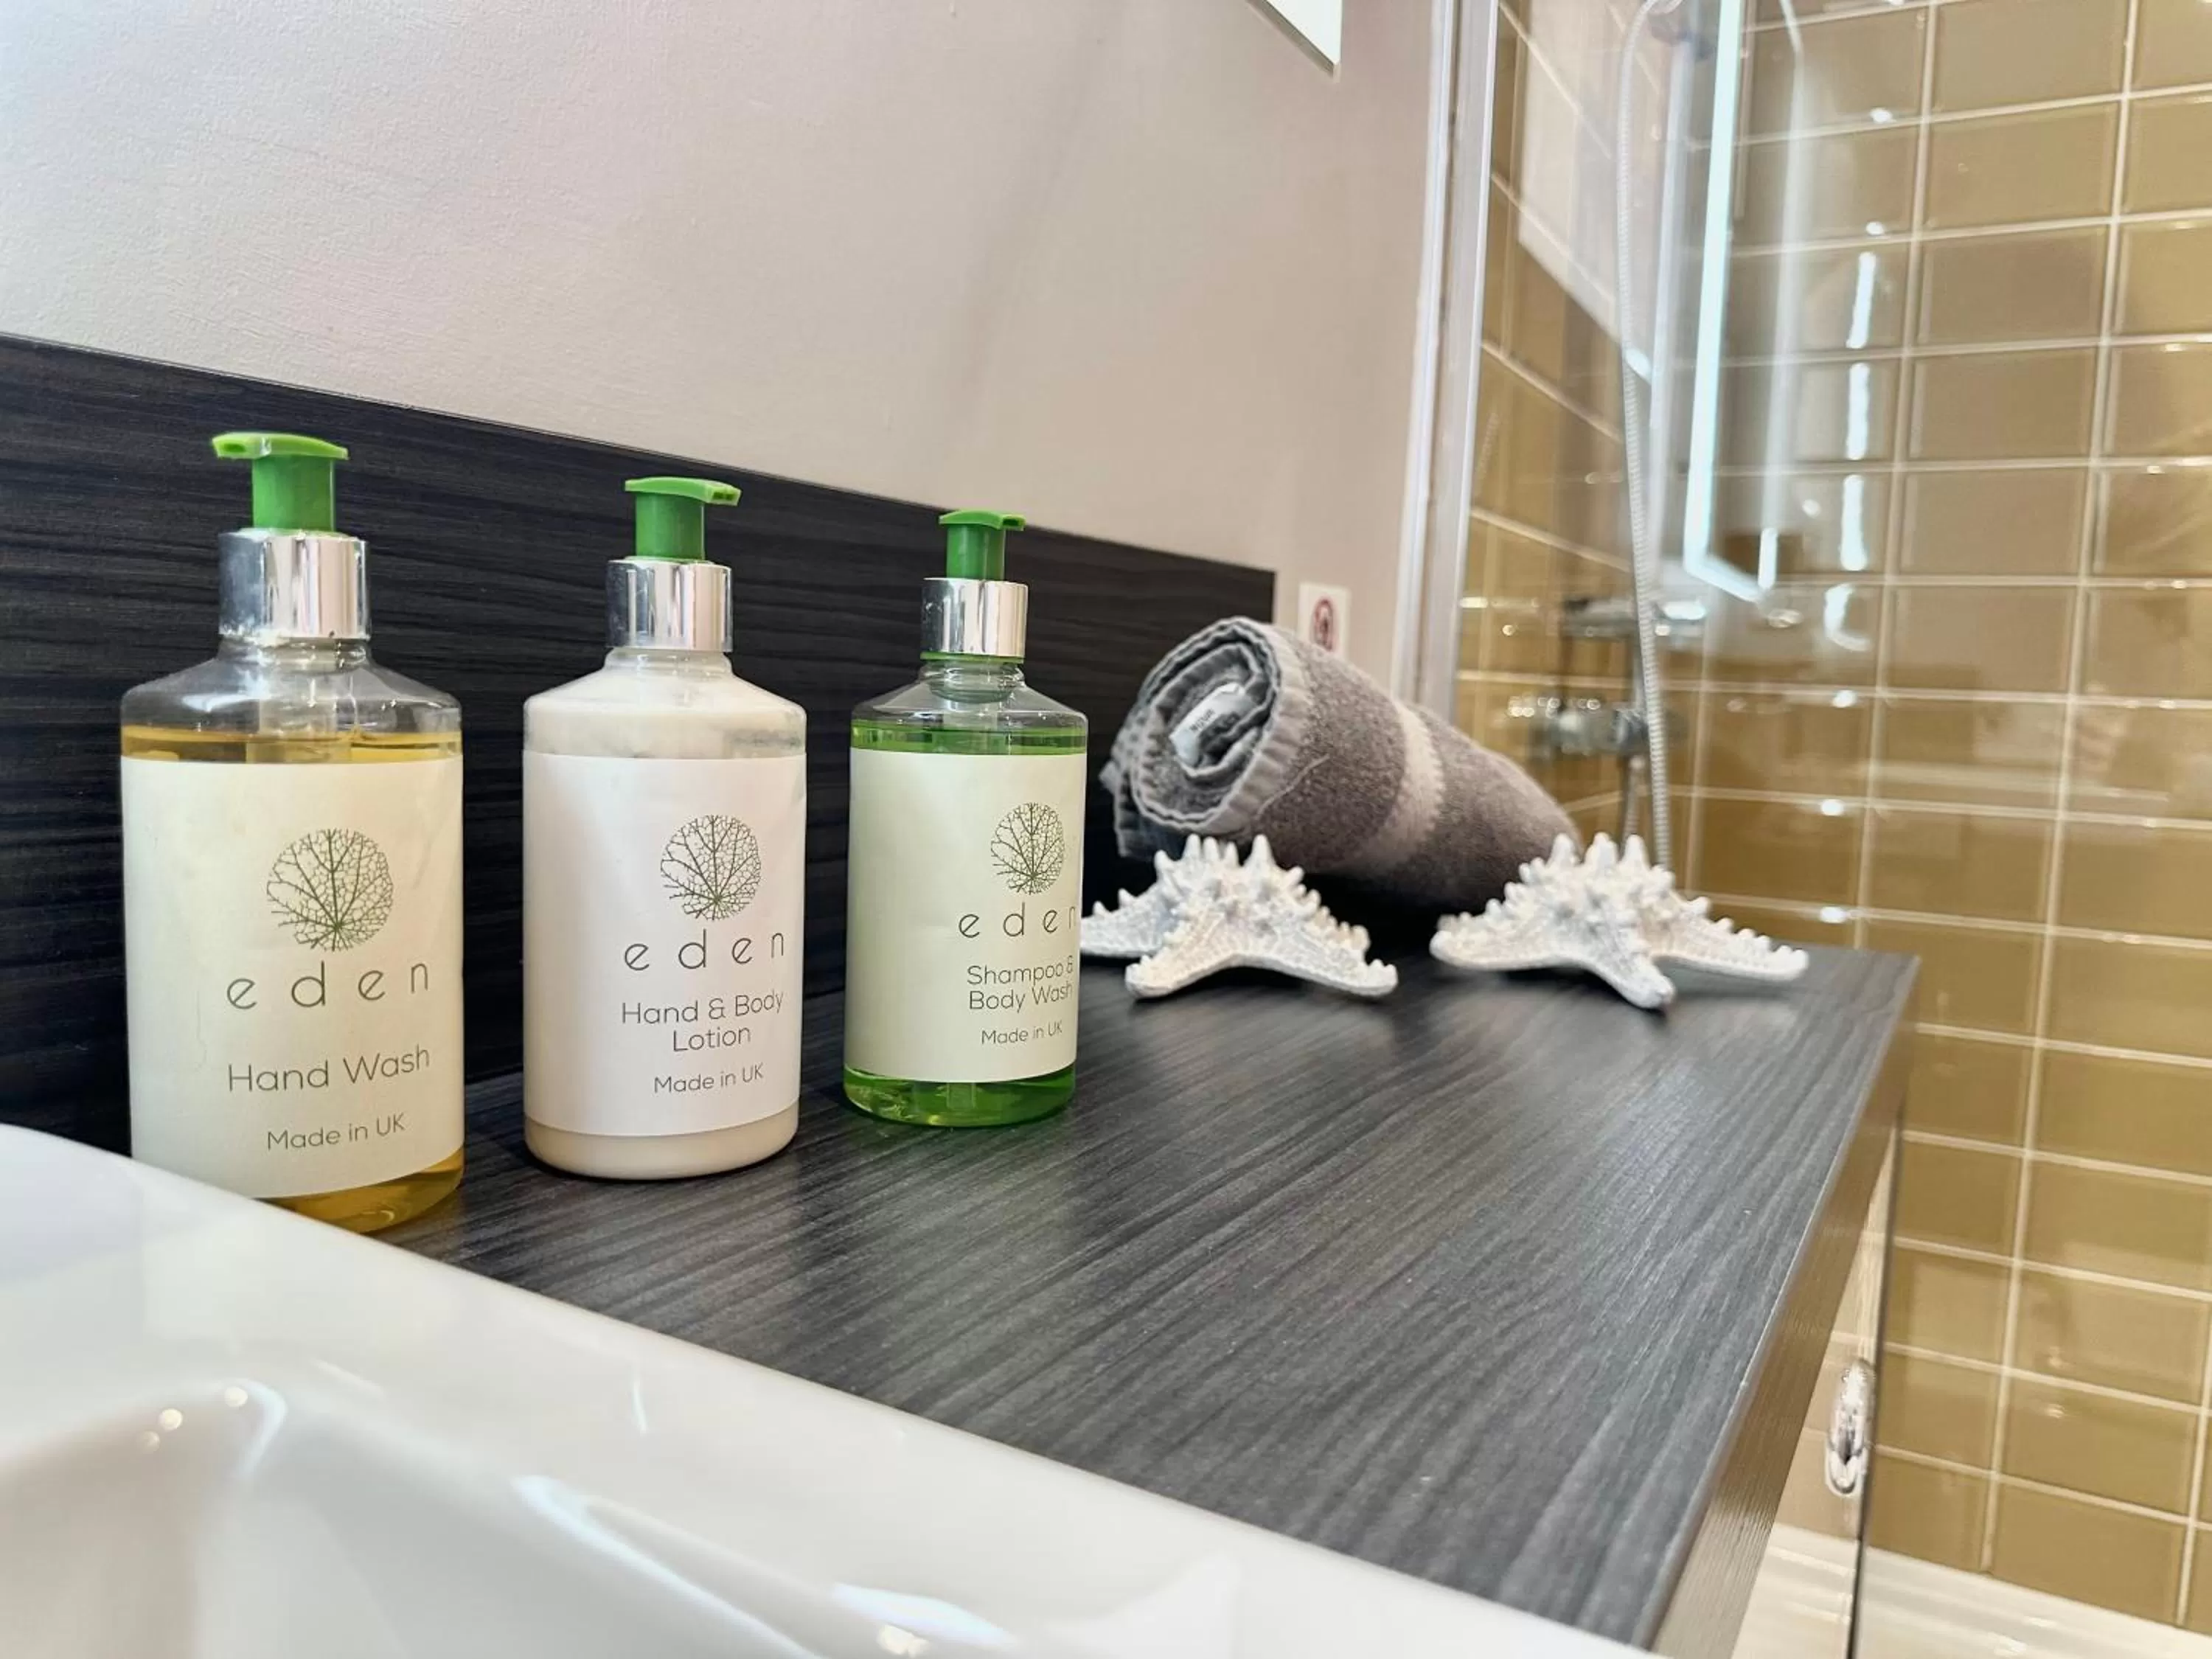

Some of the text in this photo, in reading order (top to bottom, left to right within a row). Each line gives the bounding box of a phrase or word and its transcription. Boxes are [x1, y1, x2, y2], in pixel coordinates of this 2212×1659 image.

[959, 902, 1077, 938] eden
[624, 928, 785, 971] eden
[226, 960, 429, 1009] eden
[967, 964, 1064, 986] Shampoo
[622, 990, 784, 1025] Hand & Body
[970, 981, 1073, 1013] Body Wash
[673, 1026, 751, 1052] Lotion
[981, 1020, 1062, 1045] Made in UK
[228, 1044, 430, 1092] Hand Wash
[654, 1063, 763, 1093] Made in UK
[267, 1113, 406, 1152] Made in UK
